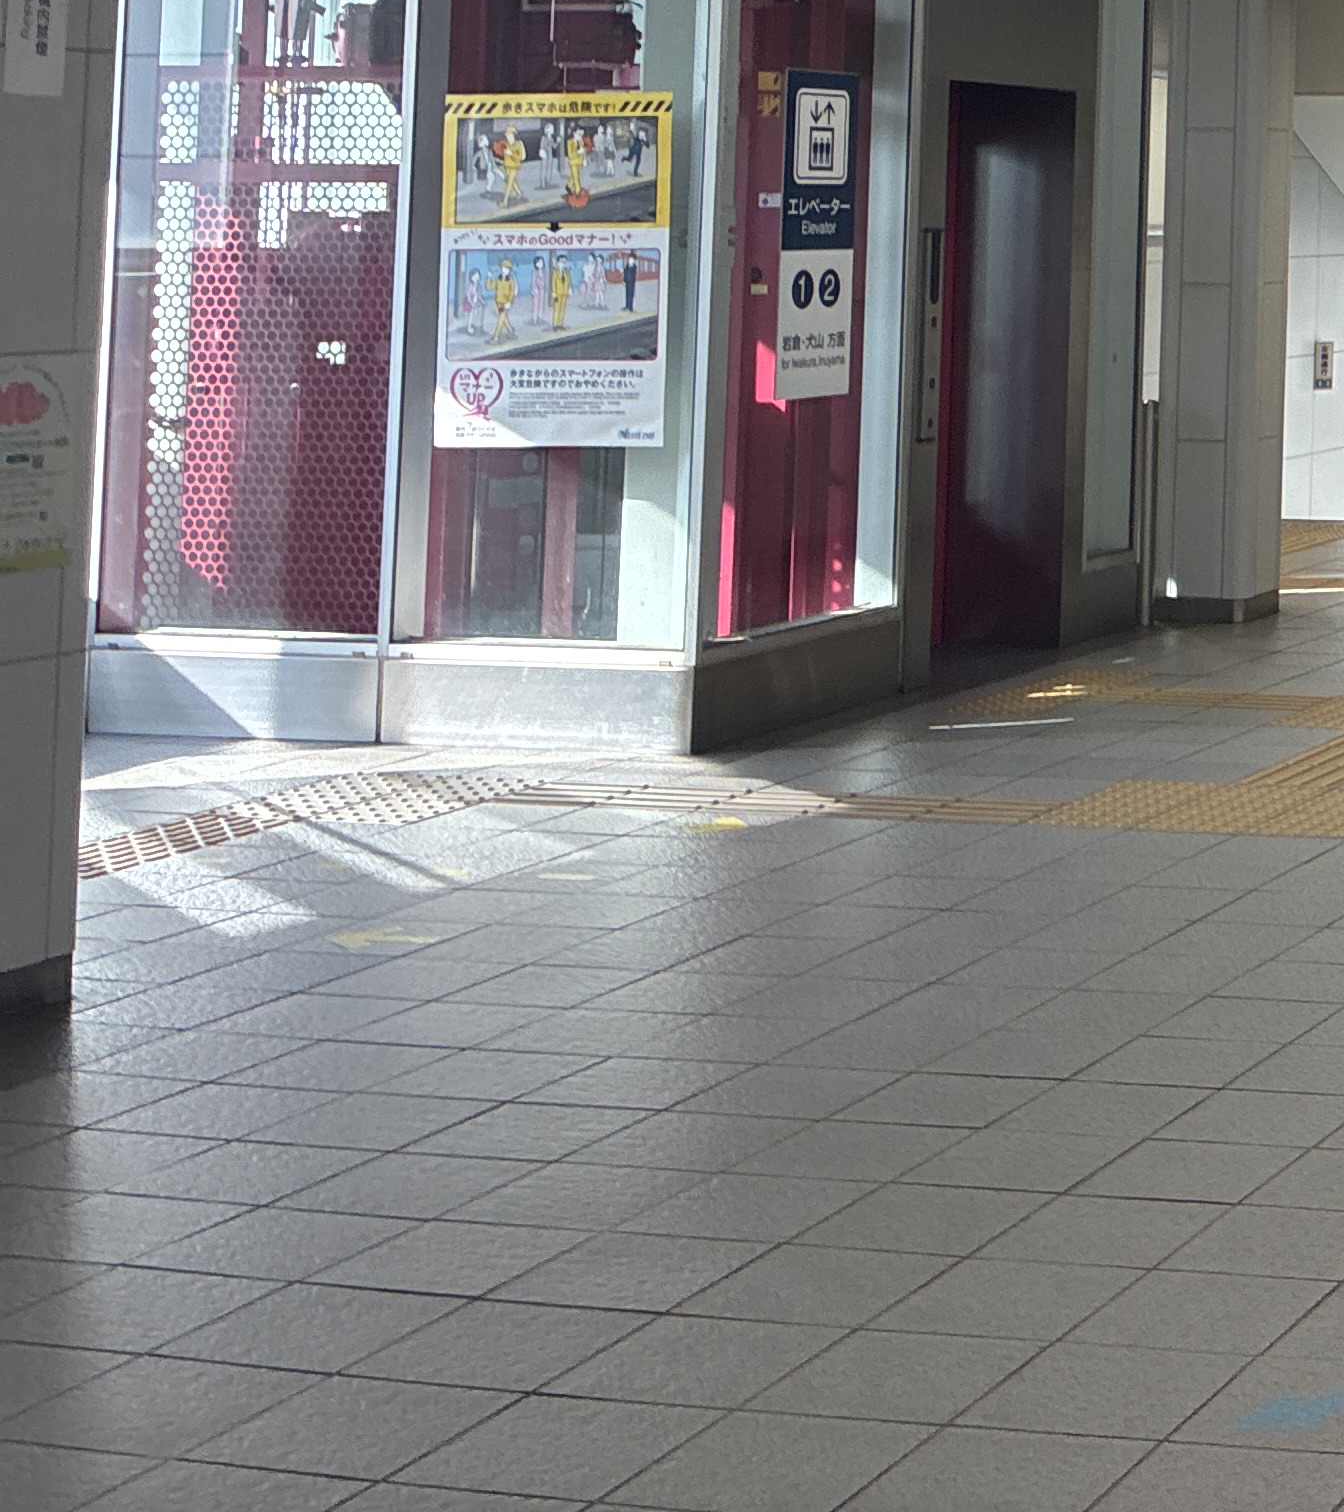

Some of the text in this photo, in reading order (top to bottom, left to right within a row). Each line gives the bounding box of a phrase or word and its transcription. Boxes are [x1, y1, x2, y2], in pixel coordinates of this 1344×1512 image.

[788, 198, 850, 215] エレベーター
[802, 219, 837, 235] Elevator
[828, 330, 845, 348] 方面
